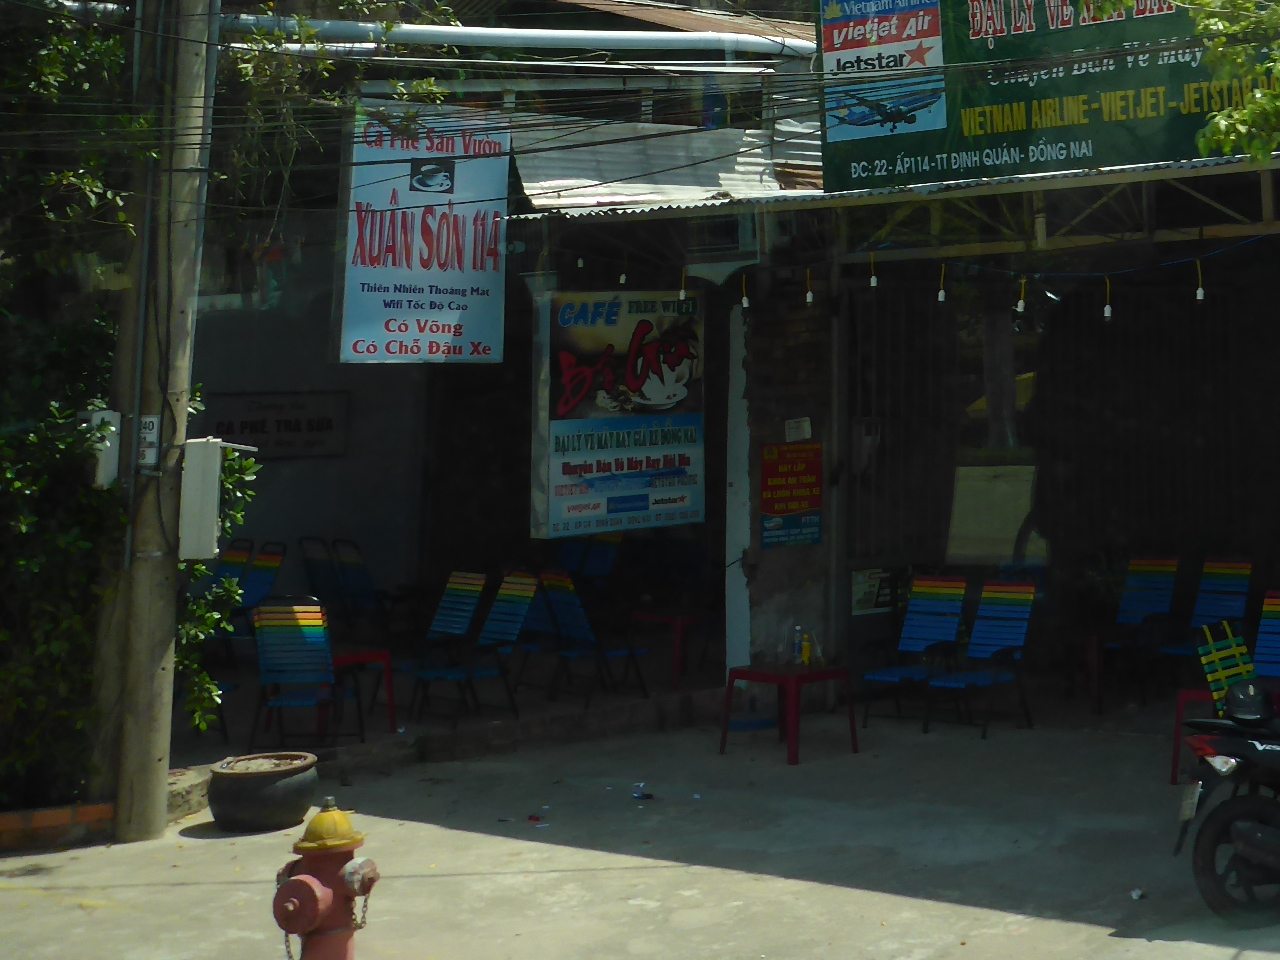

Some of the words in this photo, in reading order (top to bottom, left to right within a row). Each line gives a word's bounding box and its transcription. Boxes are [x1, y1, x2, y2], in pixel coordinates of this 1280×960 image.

[902, 11, 932, 38] Air
[829, 52, 907, 76] Jetstar
[960, 101, 1027, 137] VIETNAM
[1031, 94, 1090, 130] AIRLINE
[1101, 85, 1167, 122] VIETJET
[461, 130, 503, 157] Vườn
[950, 150, 981, 173] ĐỊNH
[1028, 136, 1067, 163] ĐỒNG
[1070, 139, 1093, 158] NAI
[351, 188, 415, 271] XUÂN
[419, 198, 466, 273] SƠN
[471, 208, 501, 273] 114
[360, 283, 390, 294] Thiên
[393, 283, 425, 295] Nhiên
[428, 283, 468, 297] Thoáng
[383, 298, 403, 310] Wifi
[406, 298, 426, 310] Tốc
[429, 299, 444, 312] Độ
[447, 301, 469, 311] Cao
[558, 294, 623, 328] CAFÉ
[628, 300, 658, 314] FREE
[384, 318, 409, 334] Có
[416, 318, 464, 336] Võng
[352, 339, 378, 355] Có
[384, 339, 421, 356] Chỗ
[428, 341, 463, 357] Đậu
[470, 342, 492, 356] Xe
